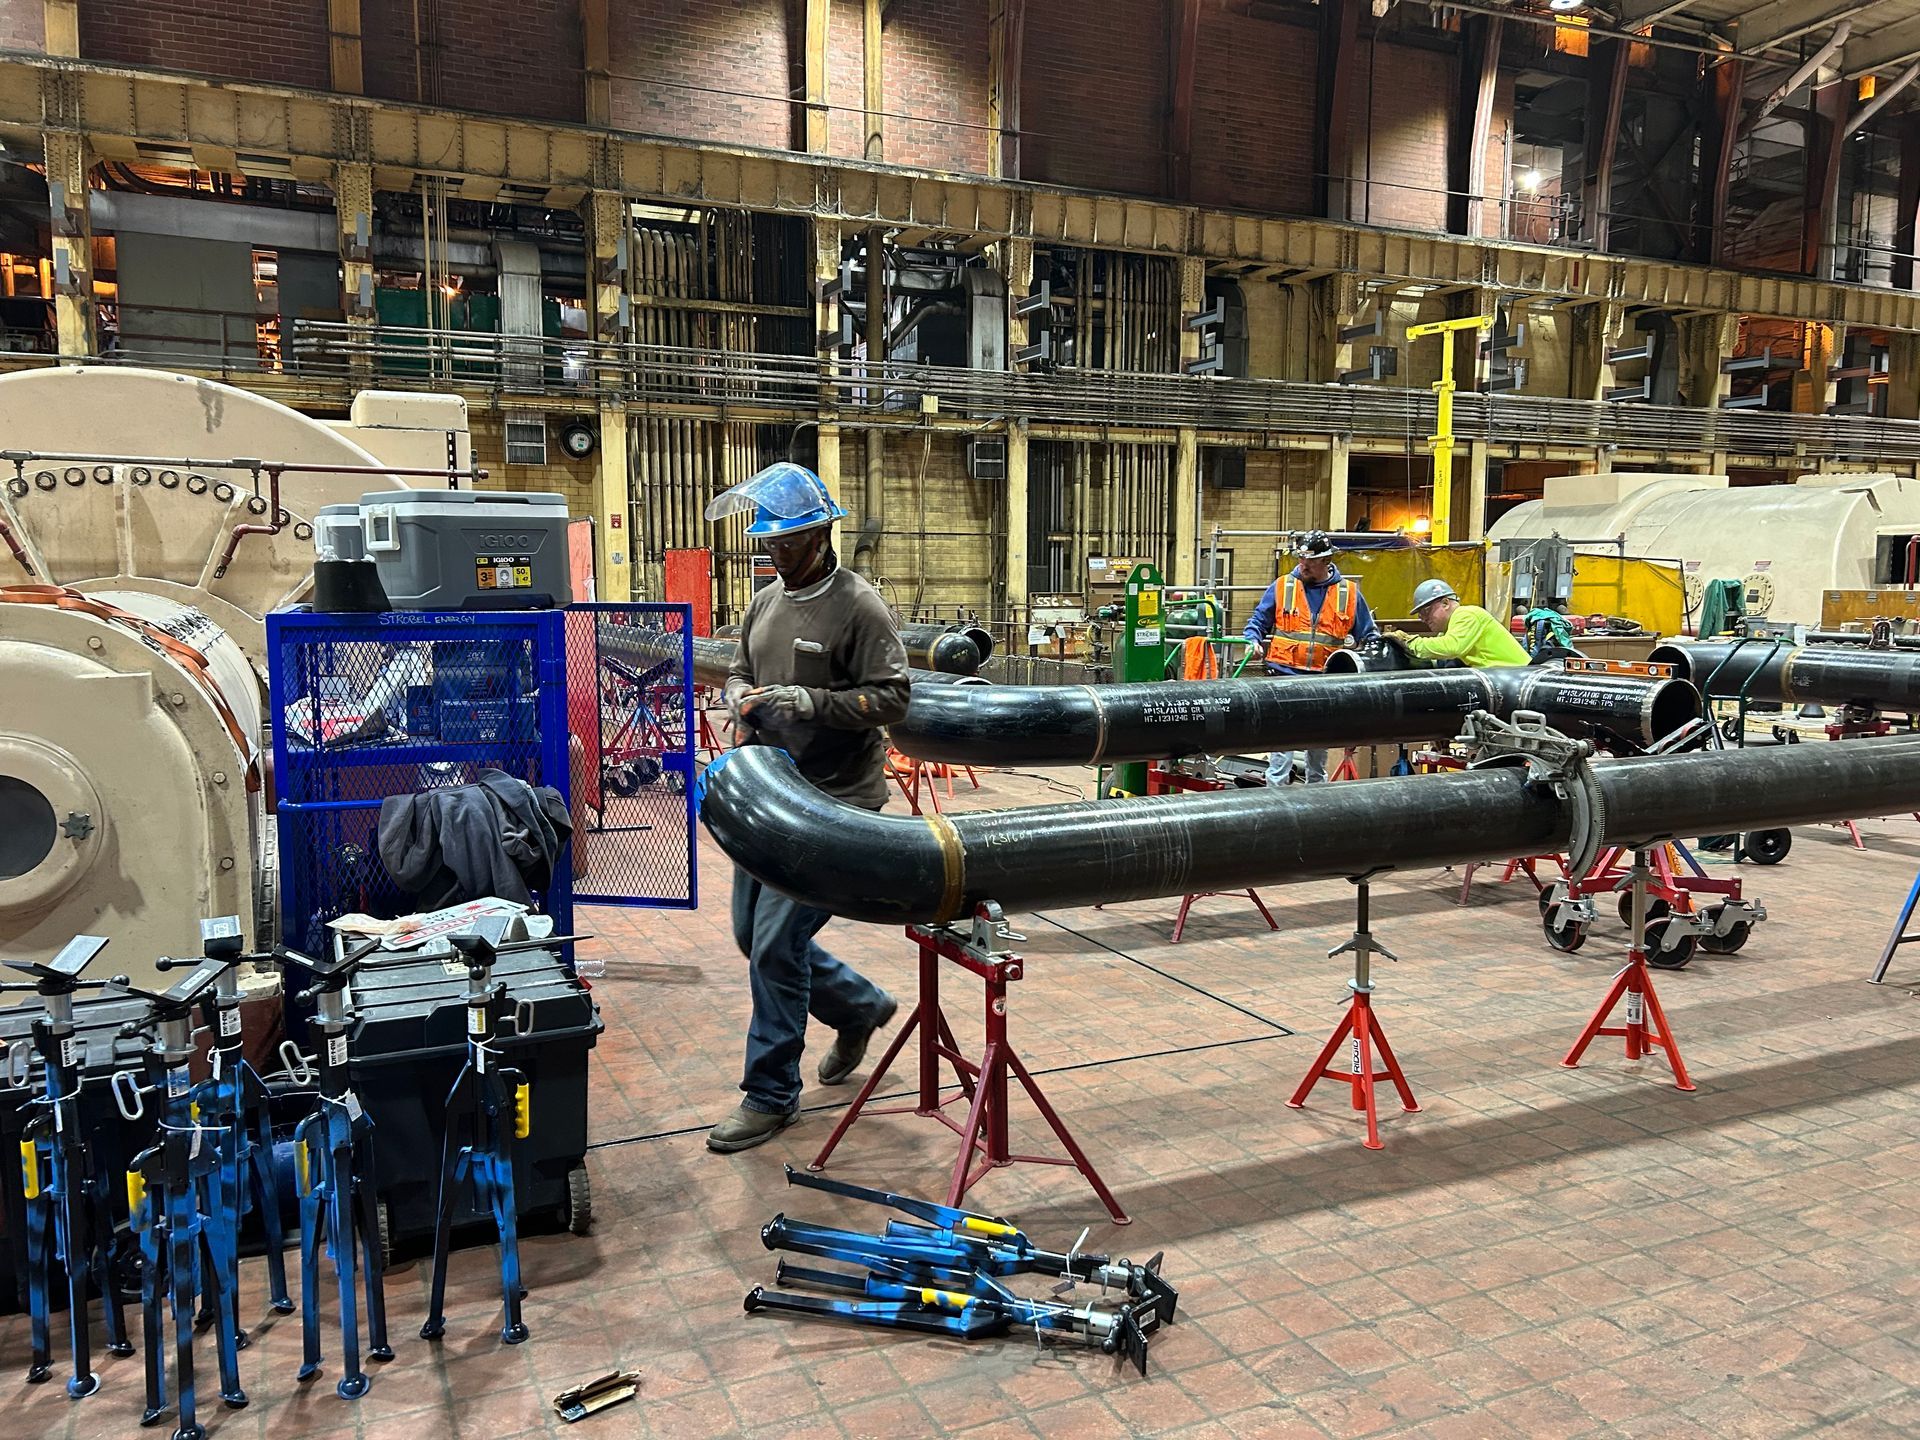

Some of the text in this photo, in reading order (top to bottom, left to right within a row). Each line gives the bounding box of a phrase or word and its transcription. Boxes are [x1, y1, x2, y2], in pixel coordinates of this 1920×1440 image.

[480, 534, 528, 548] IGLOO
[480, 572, 488, 582] 3
[377, 613, 476, 626] STROBEL ENERGY
[1600, 699, 1614, 707] TPS
[1190, 706, 1201, 714] GR
[1191, 713, 1205, 721] TPS
